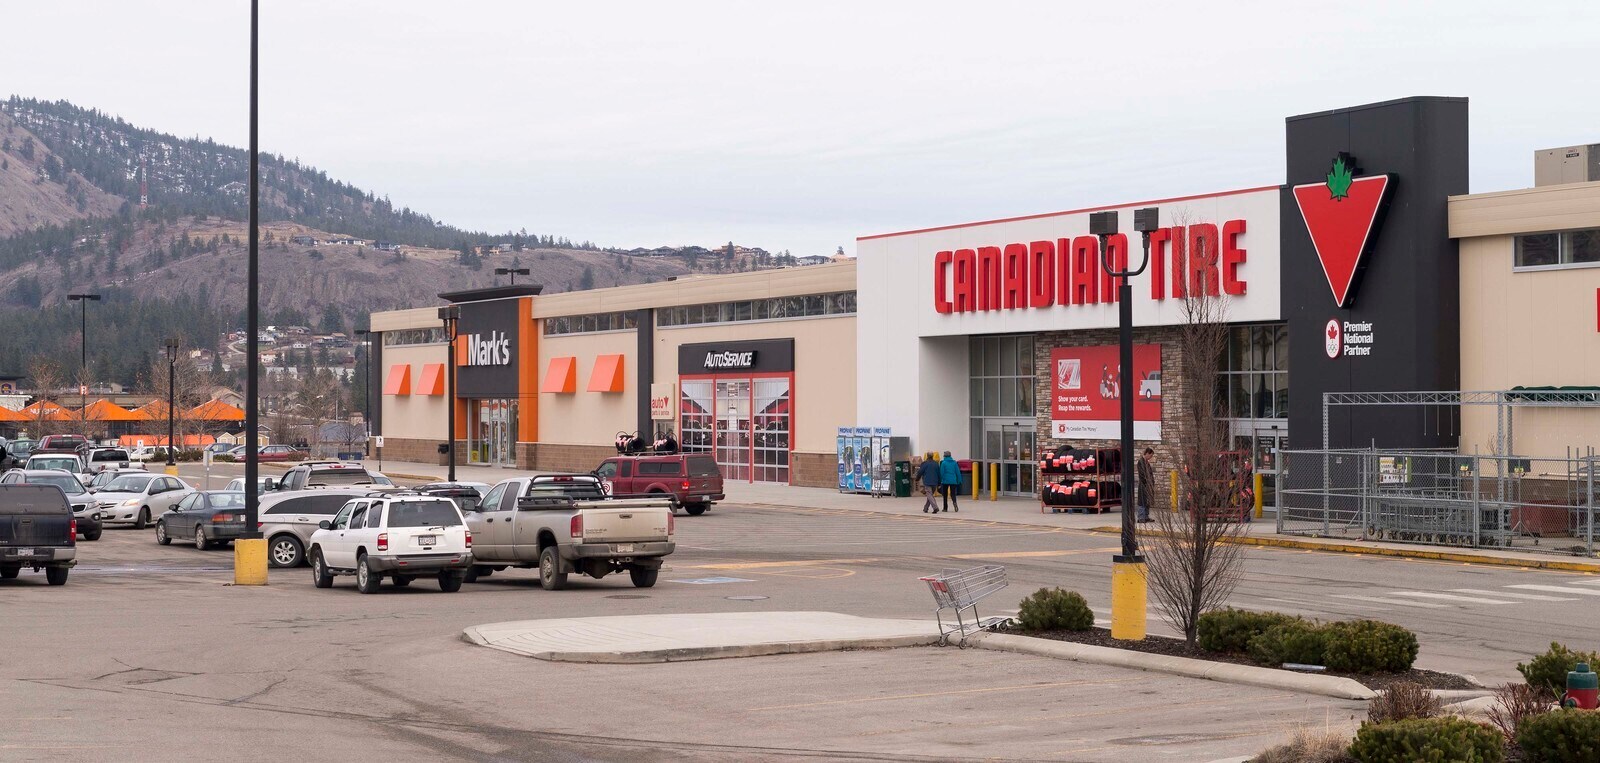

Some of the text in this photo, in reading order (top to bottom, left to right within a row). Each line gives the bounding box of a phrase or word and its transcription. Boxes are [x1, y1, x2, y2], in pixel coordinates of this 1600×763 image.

[935, 220, 1246, 314] CANADIAN TIRE
[1343, 321, 1372, 332] Premier
[1343, 332, 1373, 343] National
[468, 330, 510, 366] Mark's
[1343, 345, 1370, 355] Partner
[652, 397, 664, 409] auto
[1058, 395, 1069, 403] Show
[1058, 404, 1068, 412] Reap
